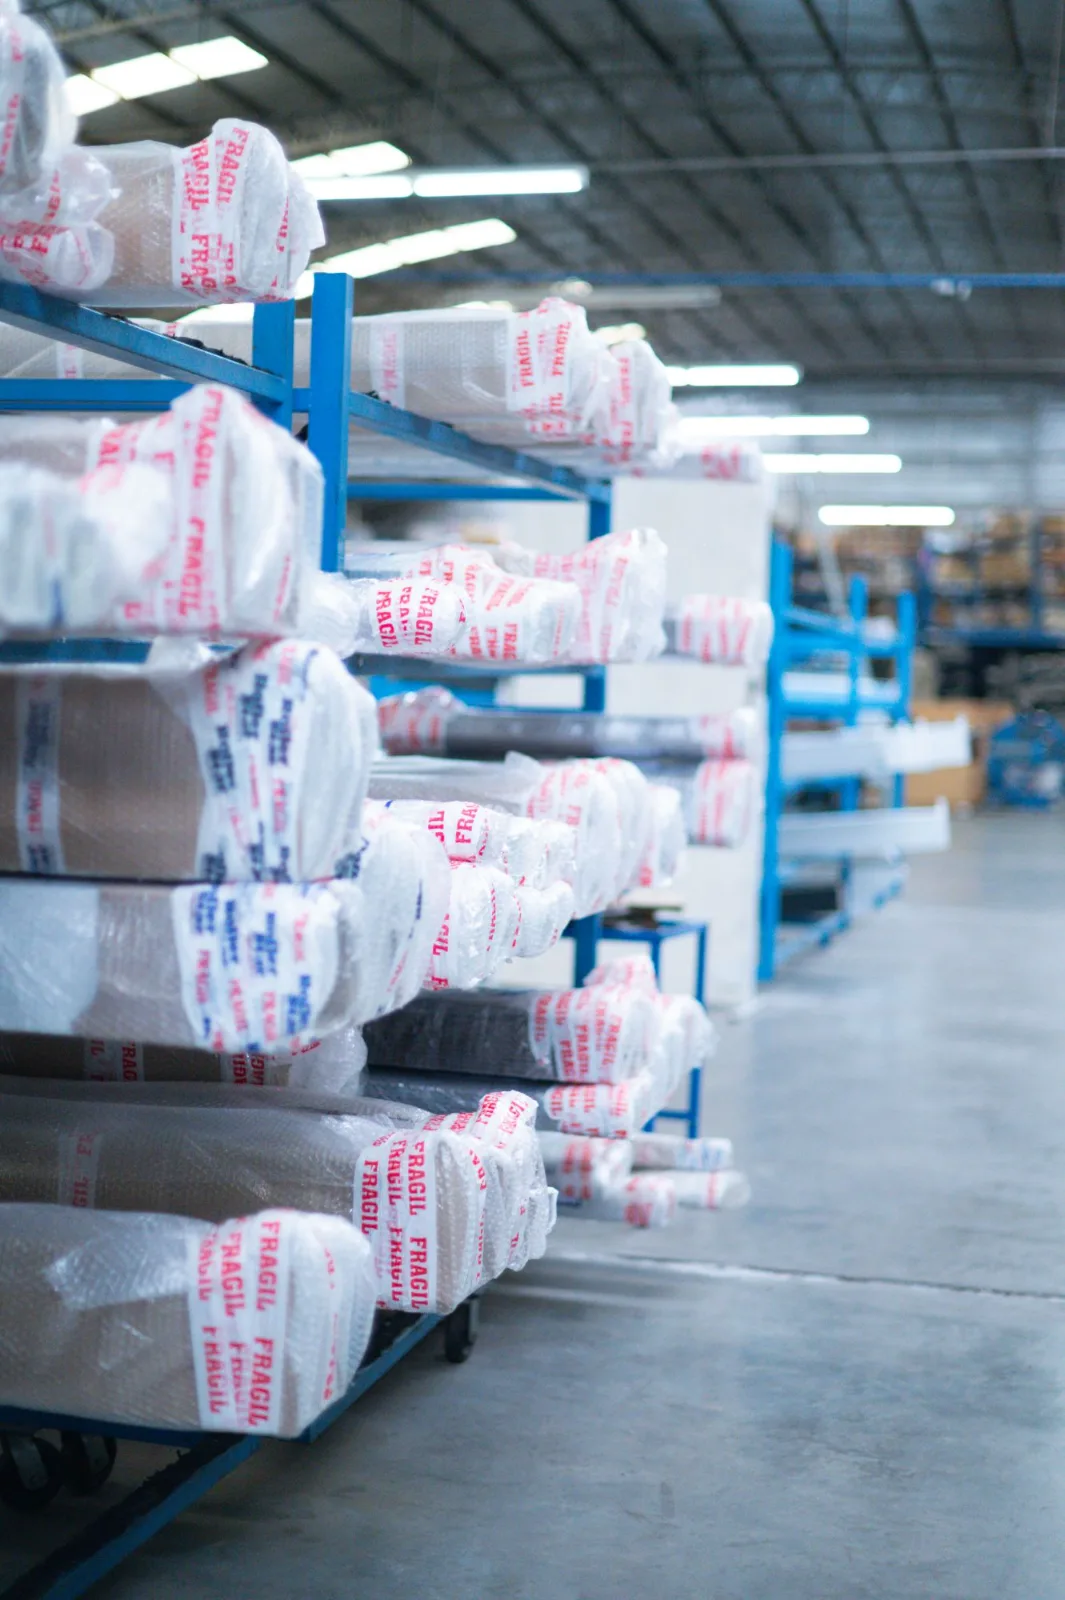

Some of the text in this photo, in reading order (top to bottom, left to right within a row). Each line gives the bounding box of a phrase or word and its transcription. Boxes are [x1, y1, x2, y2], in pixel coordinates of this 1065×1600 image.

[216, 127, 250, 206] FRAGIL
[518, 331, 536, 387] FRAGIL
[551, 321, 571, 377] FRAGIL
[179, 517, 206, 616] FRAGIL
[414, 588, 439, 646] FRAGIL
[361, 1160, 379, 1235] FRAGIL
[387, 1140, 407, 1206] FRAGIL
[408, 1141, 427, 1216] FRAGIL
[221, 1232, 246, 1318] FRAGIL
[256, 1219, 280, 1312] FRAGIL
[389, 1227, 404, 1302] FRAGIL
[410, 1237, 428, 1310] FRAGIL
[202, 1326, 228, 1414] FRAGIL
[248, 1336, 274, 1427] FRAGIL
